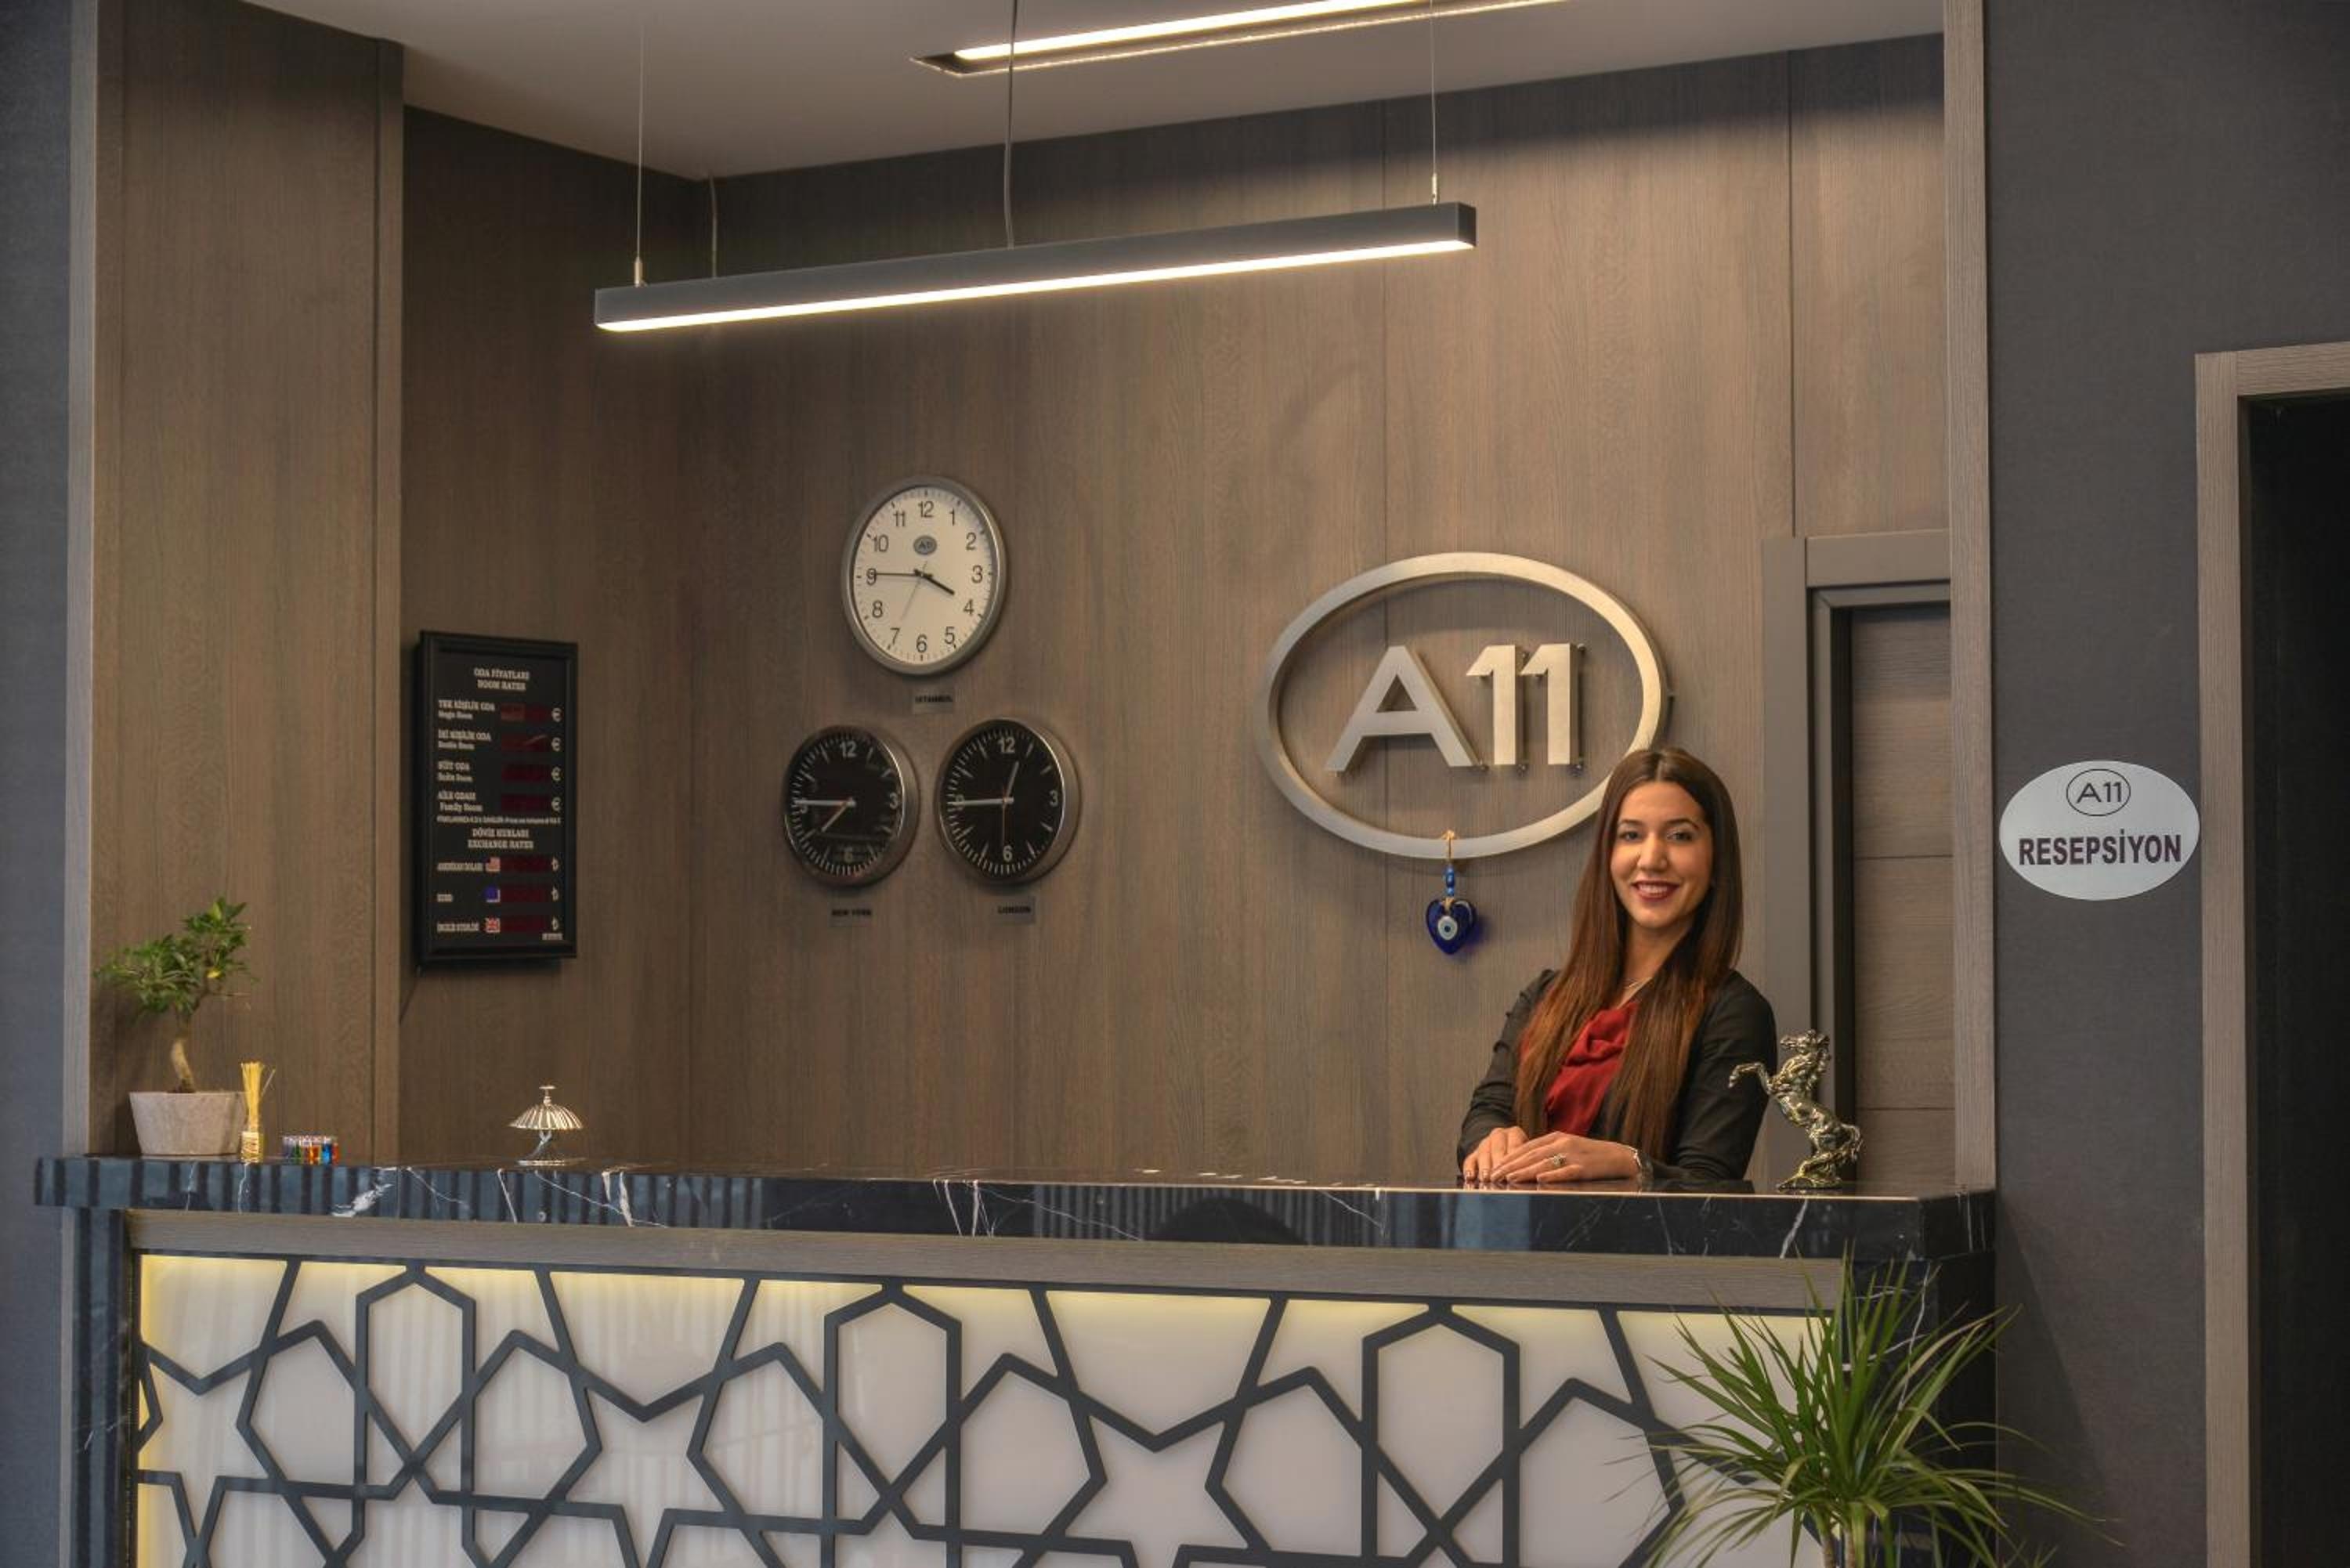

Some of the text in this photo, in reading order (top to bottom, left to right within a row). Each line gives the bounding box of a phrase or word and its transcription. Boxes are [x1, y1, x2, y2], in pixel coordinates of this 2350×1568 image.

[917, 501, 934, 518] 12
[949, 509, 956, 526] 1
[893, 513, 906, 527] 11
[873, 534, 889, 552] 10
[966, 533, 977, 550] 2
[866, 569, 877, 585] 9
[972, 565, 983, 583] 3
[873, 602, 883, 618] 8
[964, 599, 974, 615] 4
[890, 627, 900, 645] 7
[916, 634, 927, 652] 6
[945, 627, 955, 644] 5
[1325, 644, 1573, 771] A11
[839, 741, 857, 757] 12
[999, 737, 1015, 753] 12
[889, 793, 898, 809] 3
[1050, 790, 1058, 807] 3
[2077, 782, 2123, 804] A11
[844, 847, 853, 862] 6
[1003, 846, 1012, 862] 6
[2019, 829, 2182, 865] RESEPSİYON
